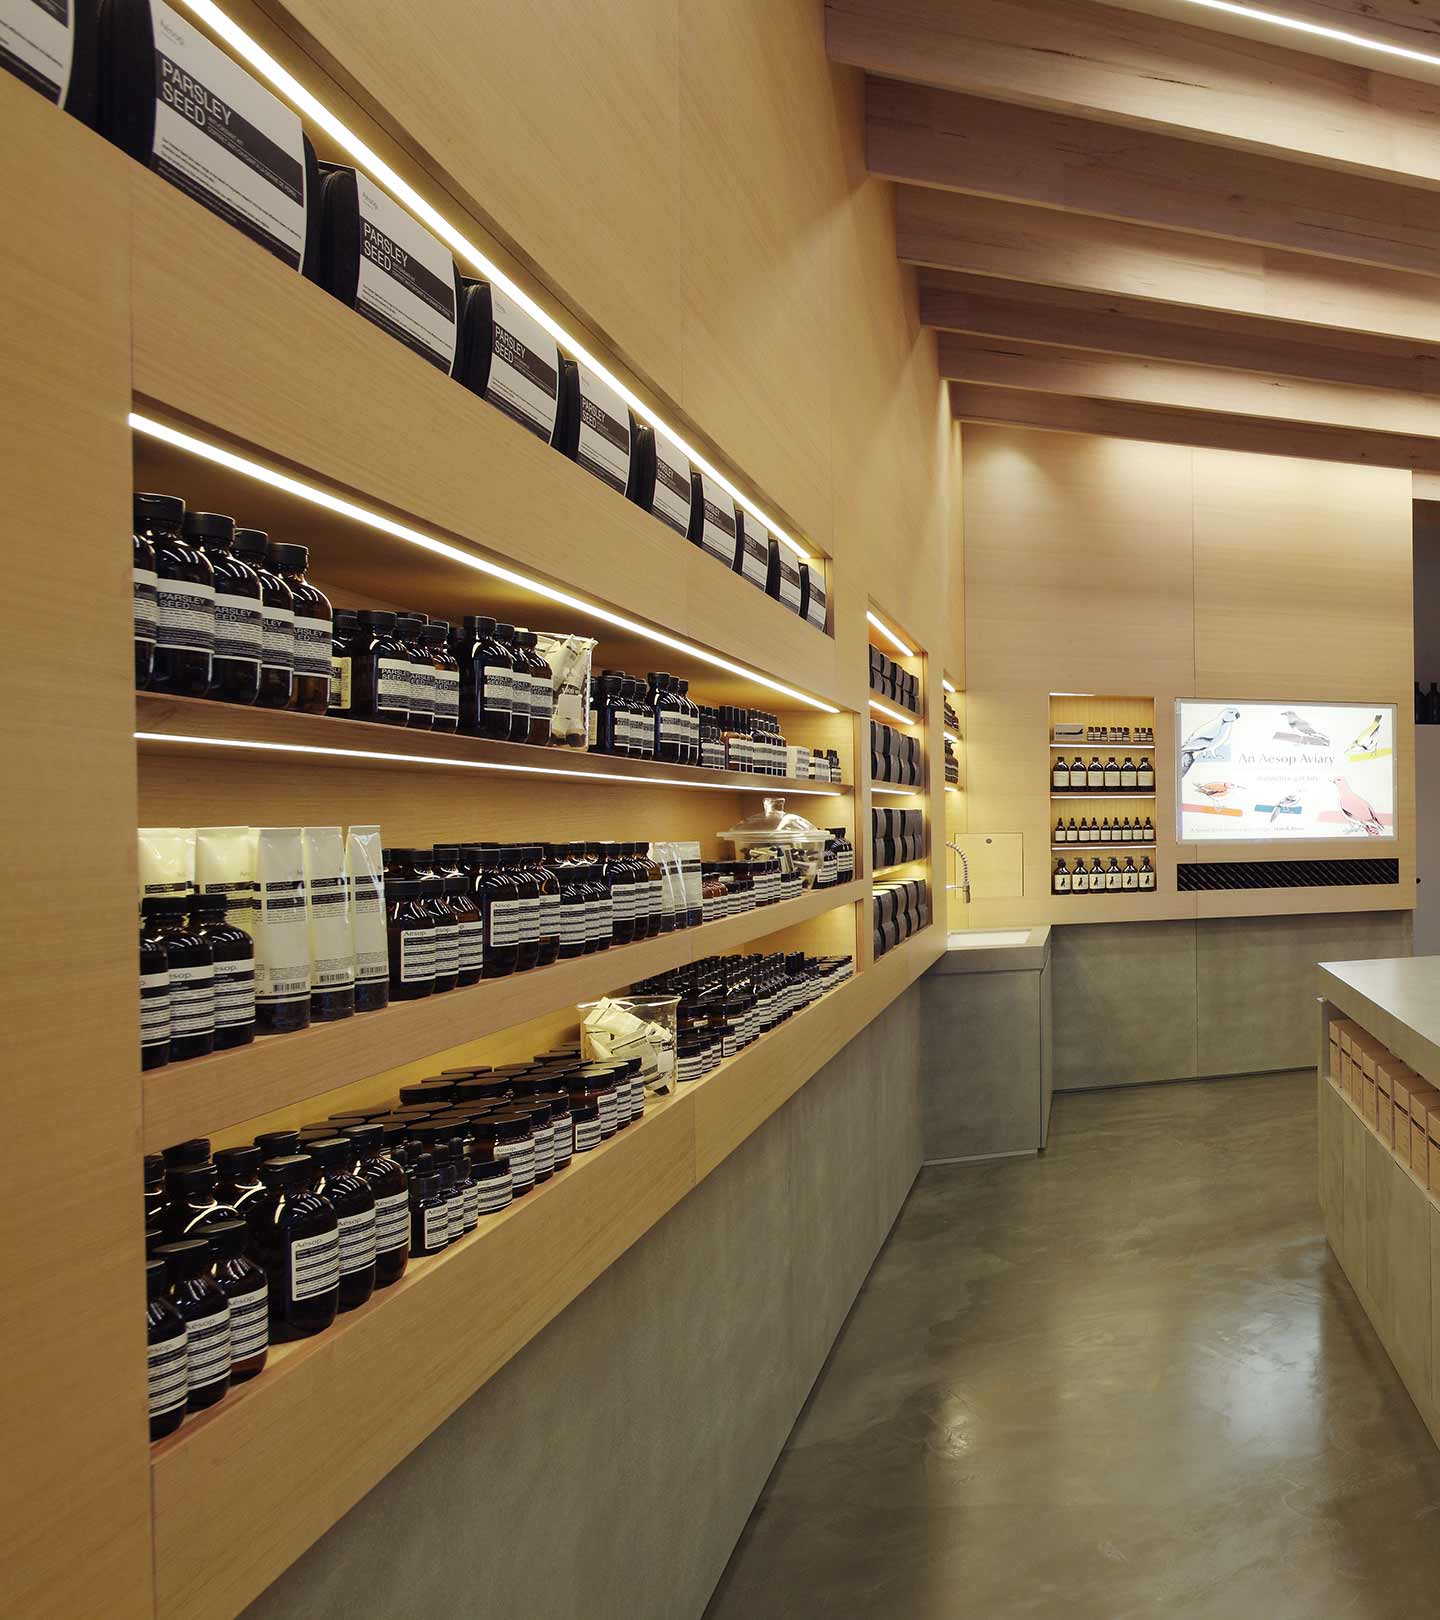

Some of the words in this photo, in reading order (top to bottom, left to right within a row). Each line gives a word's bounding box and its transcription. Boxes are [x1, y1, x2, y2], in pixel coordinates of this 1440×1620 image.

[162, 58, 231, 125] PARSLEY
[162, 81, 206, 126] SEED
[364, 222, 408, 268] PARSLEY
[364, 240, 392, 271] SEED
[495, 324, 526, 358] PARSLEY
[495, 340, 513, 363] SEED
[160, 591, 206, 605] PARSLEY
[160, 599, 191, 610] SEED
[214, 606, 253, 617] ARSLEY
[215, 613, 238, 622] EED
[410, 674, 434, 682] ARSLEY
[1238, 753, 1256, 763] An
[1259, 753, 1297, 766] Aesop
[1300, 753, 1336, 766] Aviary
[296, 1239, 323, 1248] Aesop
